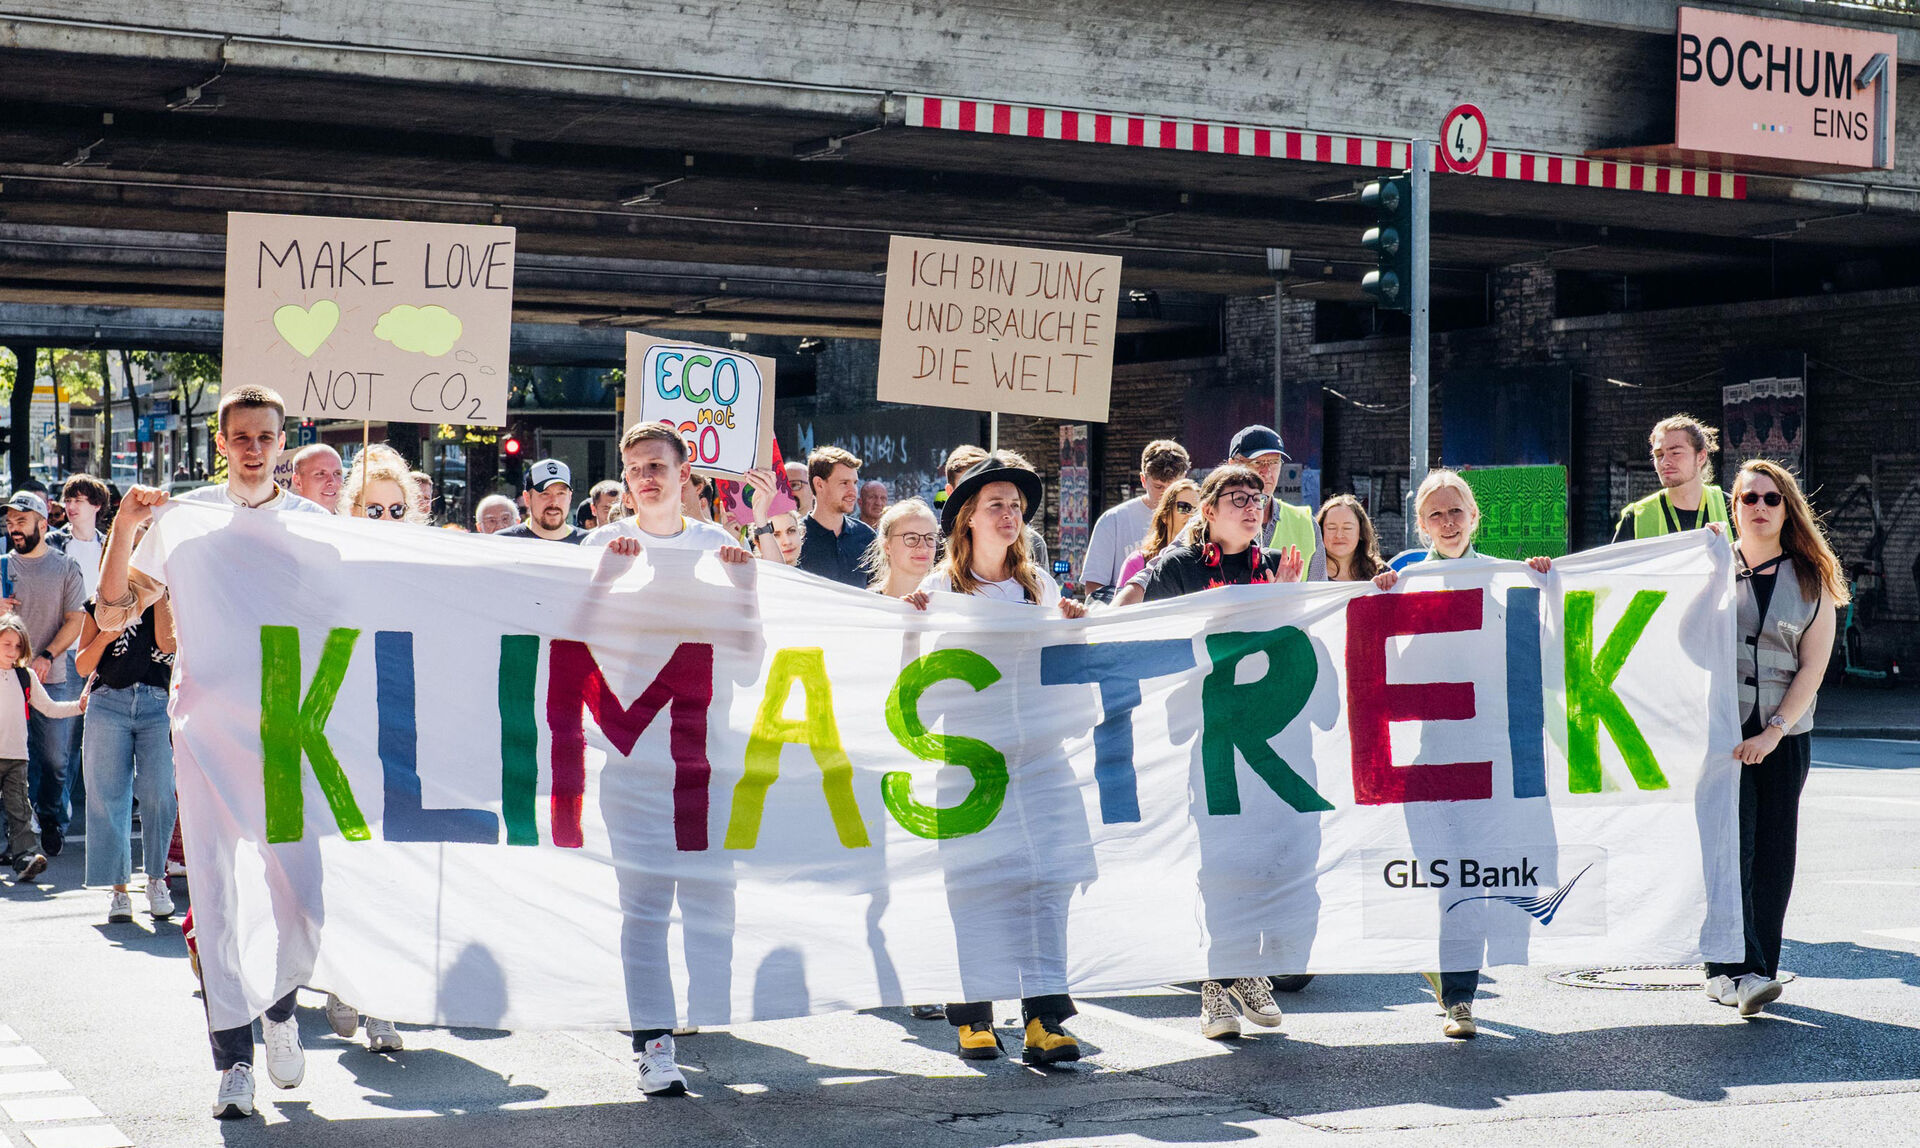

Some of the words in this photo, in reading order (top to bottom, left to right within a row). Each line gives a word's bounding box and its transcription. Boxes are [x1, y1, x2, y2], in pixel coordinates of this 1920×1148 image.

[1680, 33, 1853, 100] BOCHUM
[1455, 123, 1465, 153] 4
[1813, 107, 1868, 141] EINS
[257, 239, 394, 289] MAKE
[424, 241, 511, 289] LOVE
[911, 250, 959, 290] ICH
[970, 256, 1017, 296] BIN
[1025, 260, 1106, 304] JUNG
[907, 300, 963, 333] UND
[972, 305, 1101, 346] BRAUCHE
[302, 370, 384, 411] NOT
[655, 351, 740, 406] ECO
[912, 345, 972, 385] DIE
[991, 351, 1093, 396] WELT
[697, 405, 736, 430] not
[658, 418, 720, 464] GO
[260, 587, 1671, 852] KLIMASTREIK
[1383, 859, 1450, 888] GLS
[1460, 857, 1539, 888] Bank
